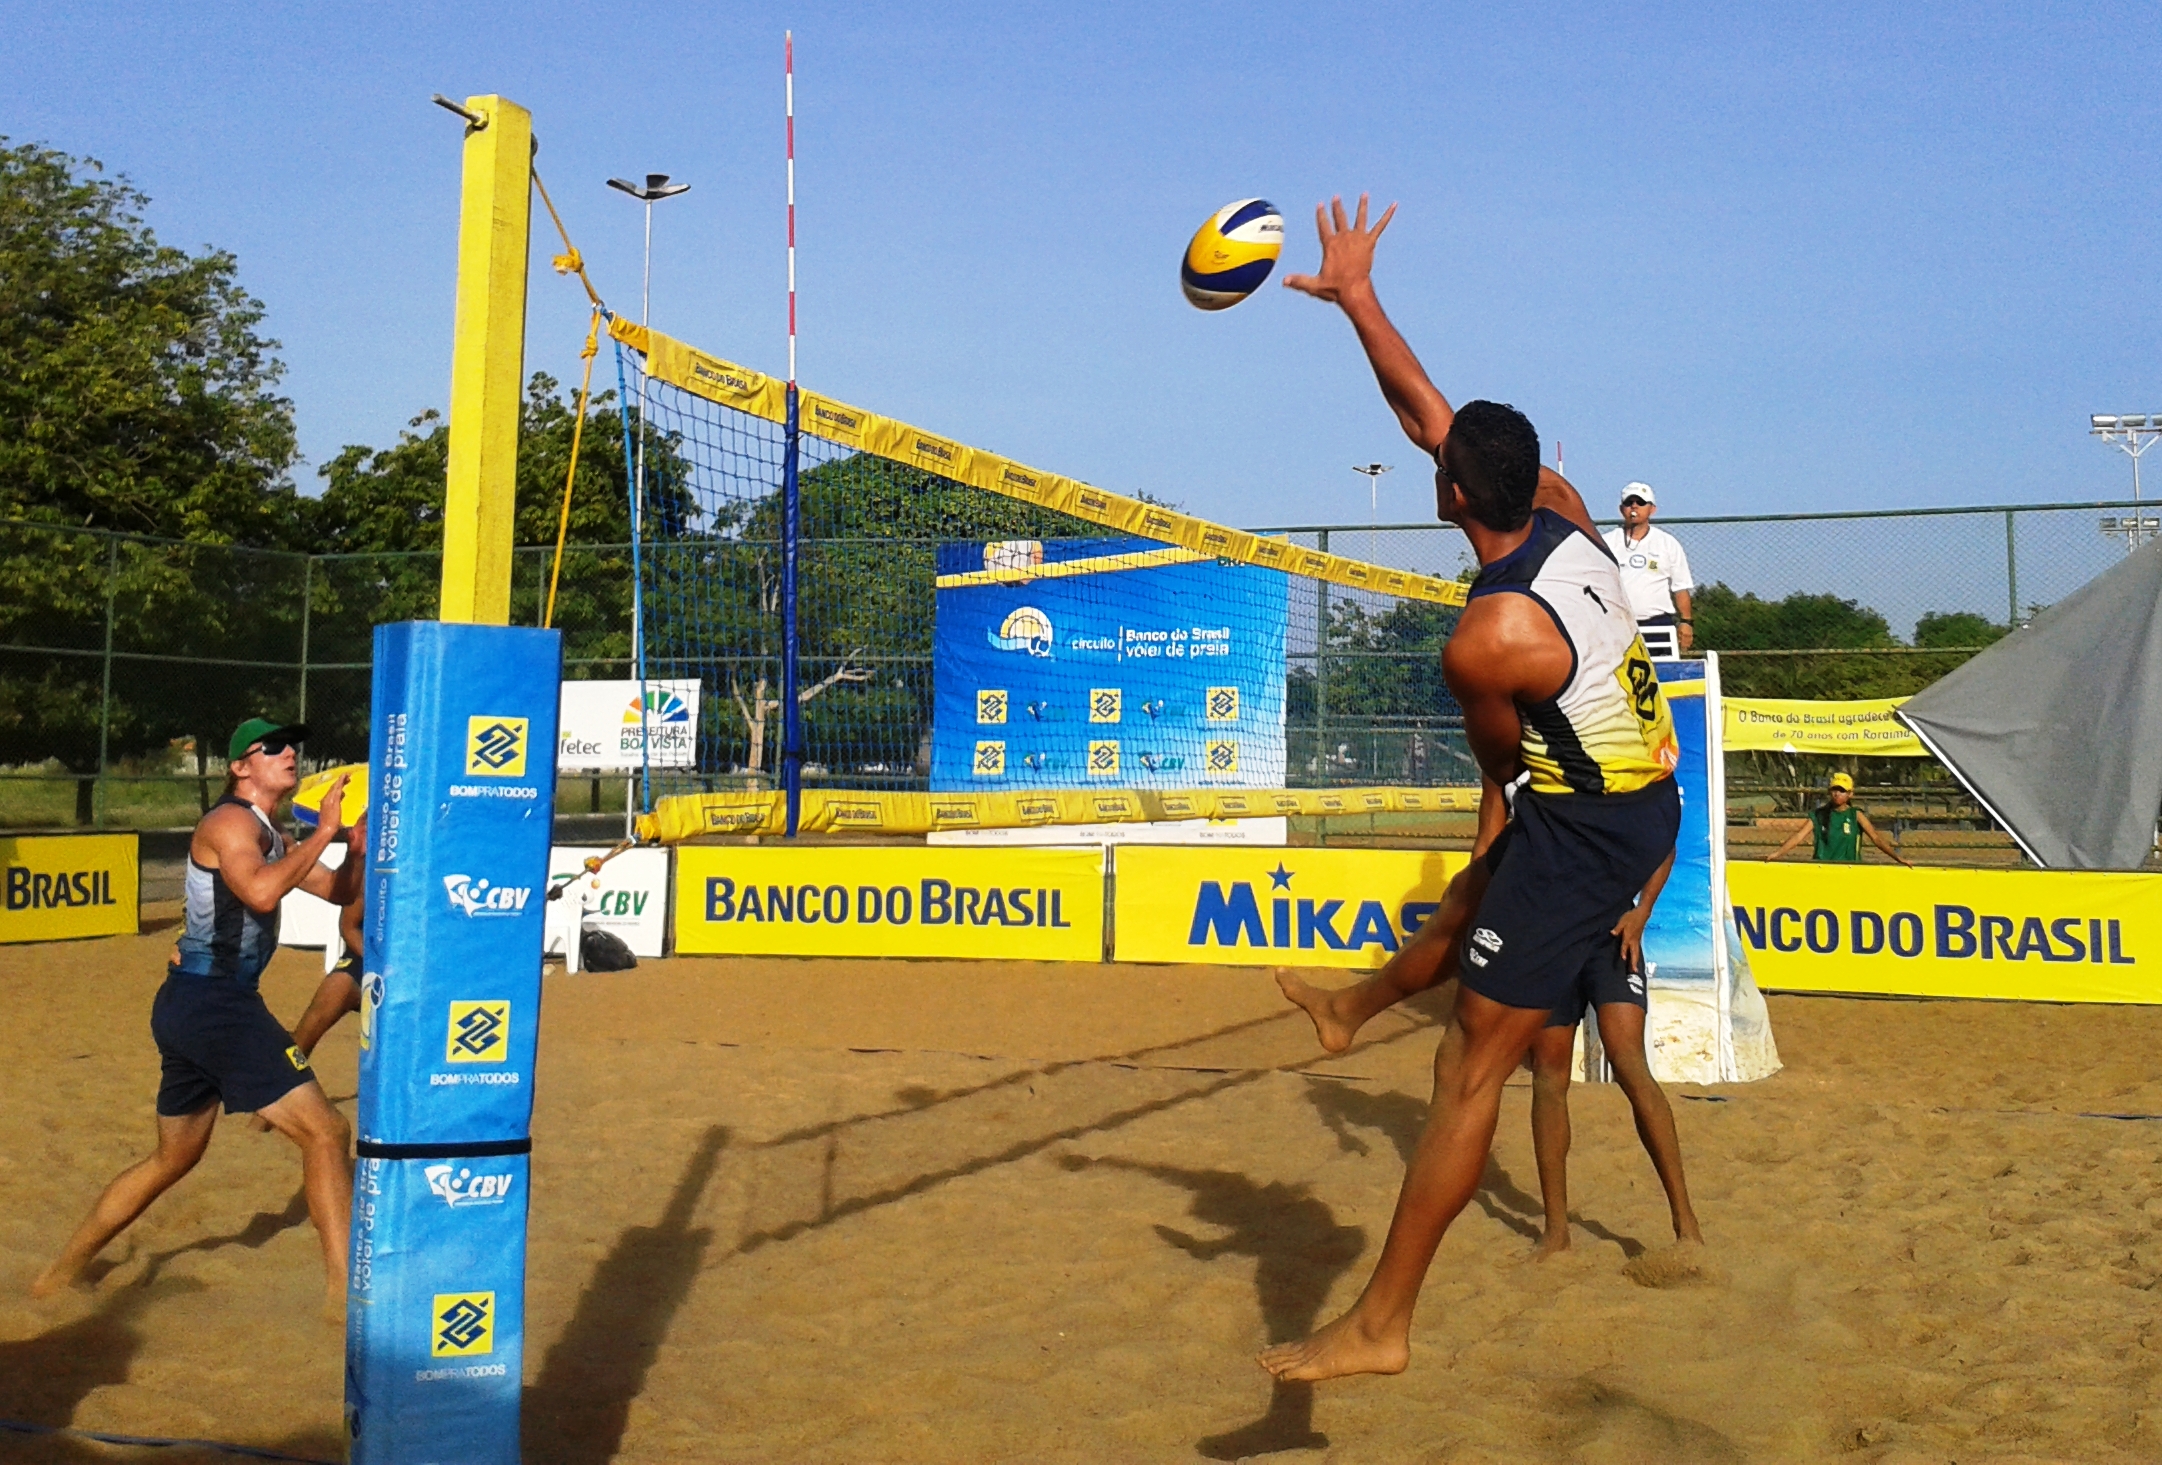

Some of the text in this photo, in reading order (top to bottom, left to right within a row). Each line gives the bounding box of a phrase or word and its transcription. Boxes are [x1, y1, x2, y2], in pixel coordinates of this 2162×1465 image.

[1583, 585, 1608, 614] 1
[1072, 637, 1115, 650] circuito
[1126, 627, 1230, 642] Banco do Brasil
[1166, 642, 1185, 658] de
[1190, 644, 1230, 659] praia
[1739, 710, 1890, 725] O Banco do Brasil agradece
[394, 713, 408, 769] praia
[621, 726, 688, 738] PREEITURA
[651, 737, 688, 750] VISTA
[1773, 729, 1786, 739] de
[1791, 730, 1804, 739] 70
[1808, 732, 1833, 740] anos
[1837, 732, 1858, 740] com
[376, 713, 396, 863] Banco do Brasil
[391, 775, 403, 803] de
[450, 785, 538, 799] BOMPRATODOS
[7, 867, 116, 910] BRASIL
[486, 887, 531, 910] CBV
[377, 878, 388, 943] circuito
[600, 890, 650, 916] CBV
[705, 876, 1071, 928] BANCO DO BRASIL
[1733, 904, 2136, 965] NCO DO BRASIL
[430, 1072, 519, 1086] BOMPRATODOS
[468, 1174, 513, 1197] CBV
[364, 1204, 376, 1231] de
